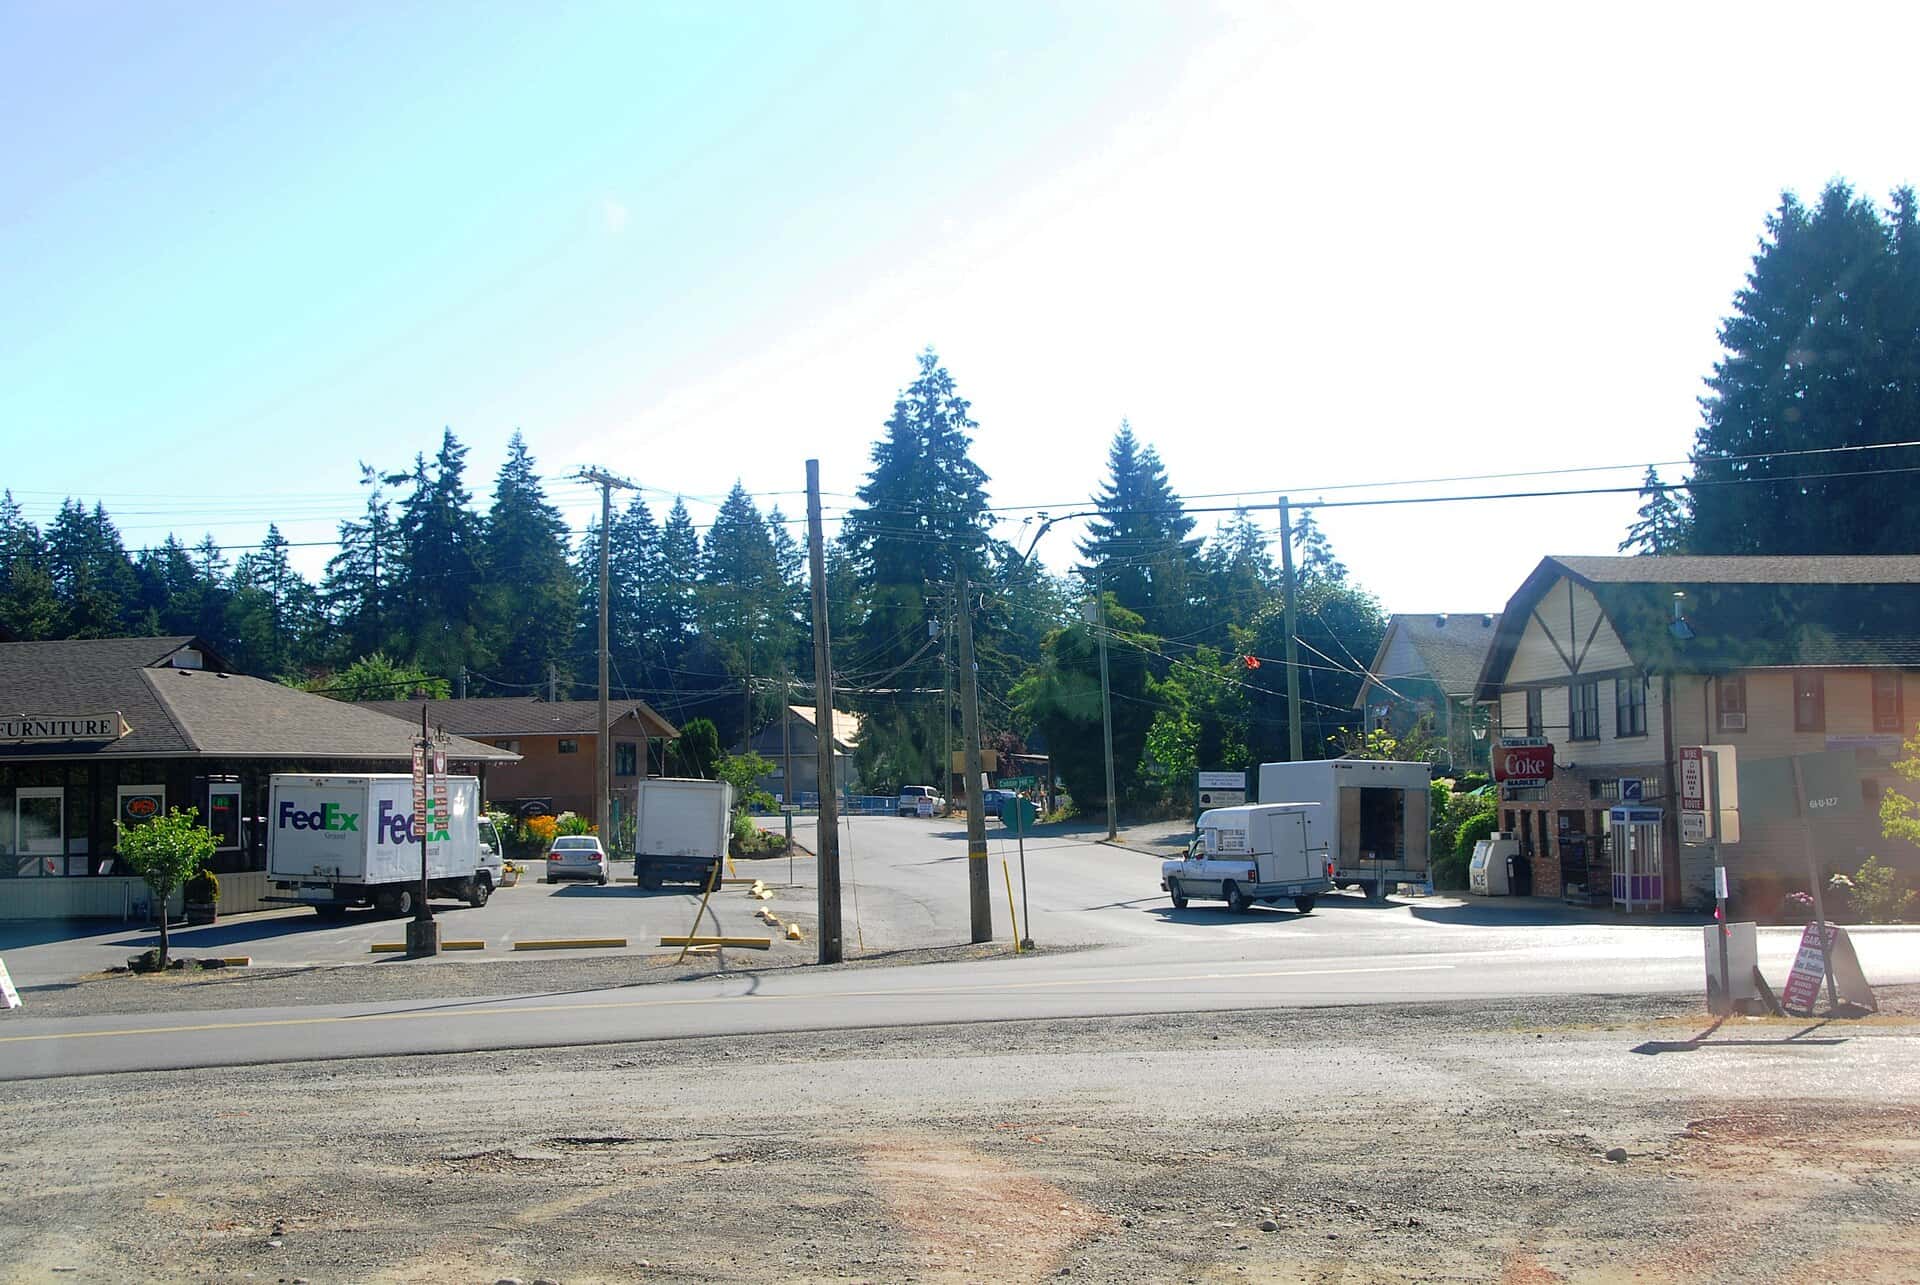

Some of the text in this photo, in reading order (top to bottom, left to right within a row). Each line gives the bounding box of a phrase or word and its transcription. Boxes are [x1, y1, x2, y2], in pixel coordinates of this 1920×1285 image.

[1504, 754, 1545, 775] Coke
[1507, 779, 1539, 787] MARKET
[1684, 800, 1701, 809] ROUTE
[279, 801, 359, 832] FedEx
[1472, 874, 1486, 886] ICE
